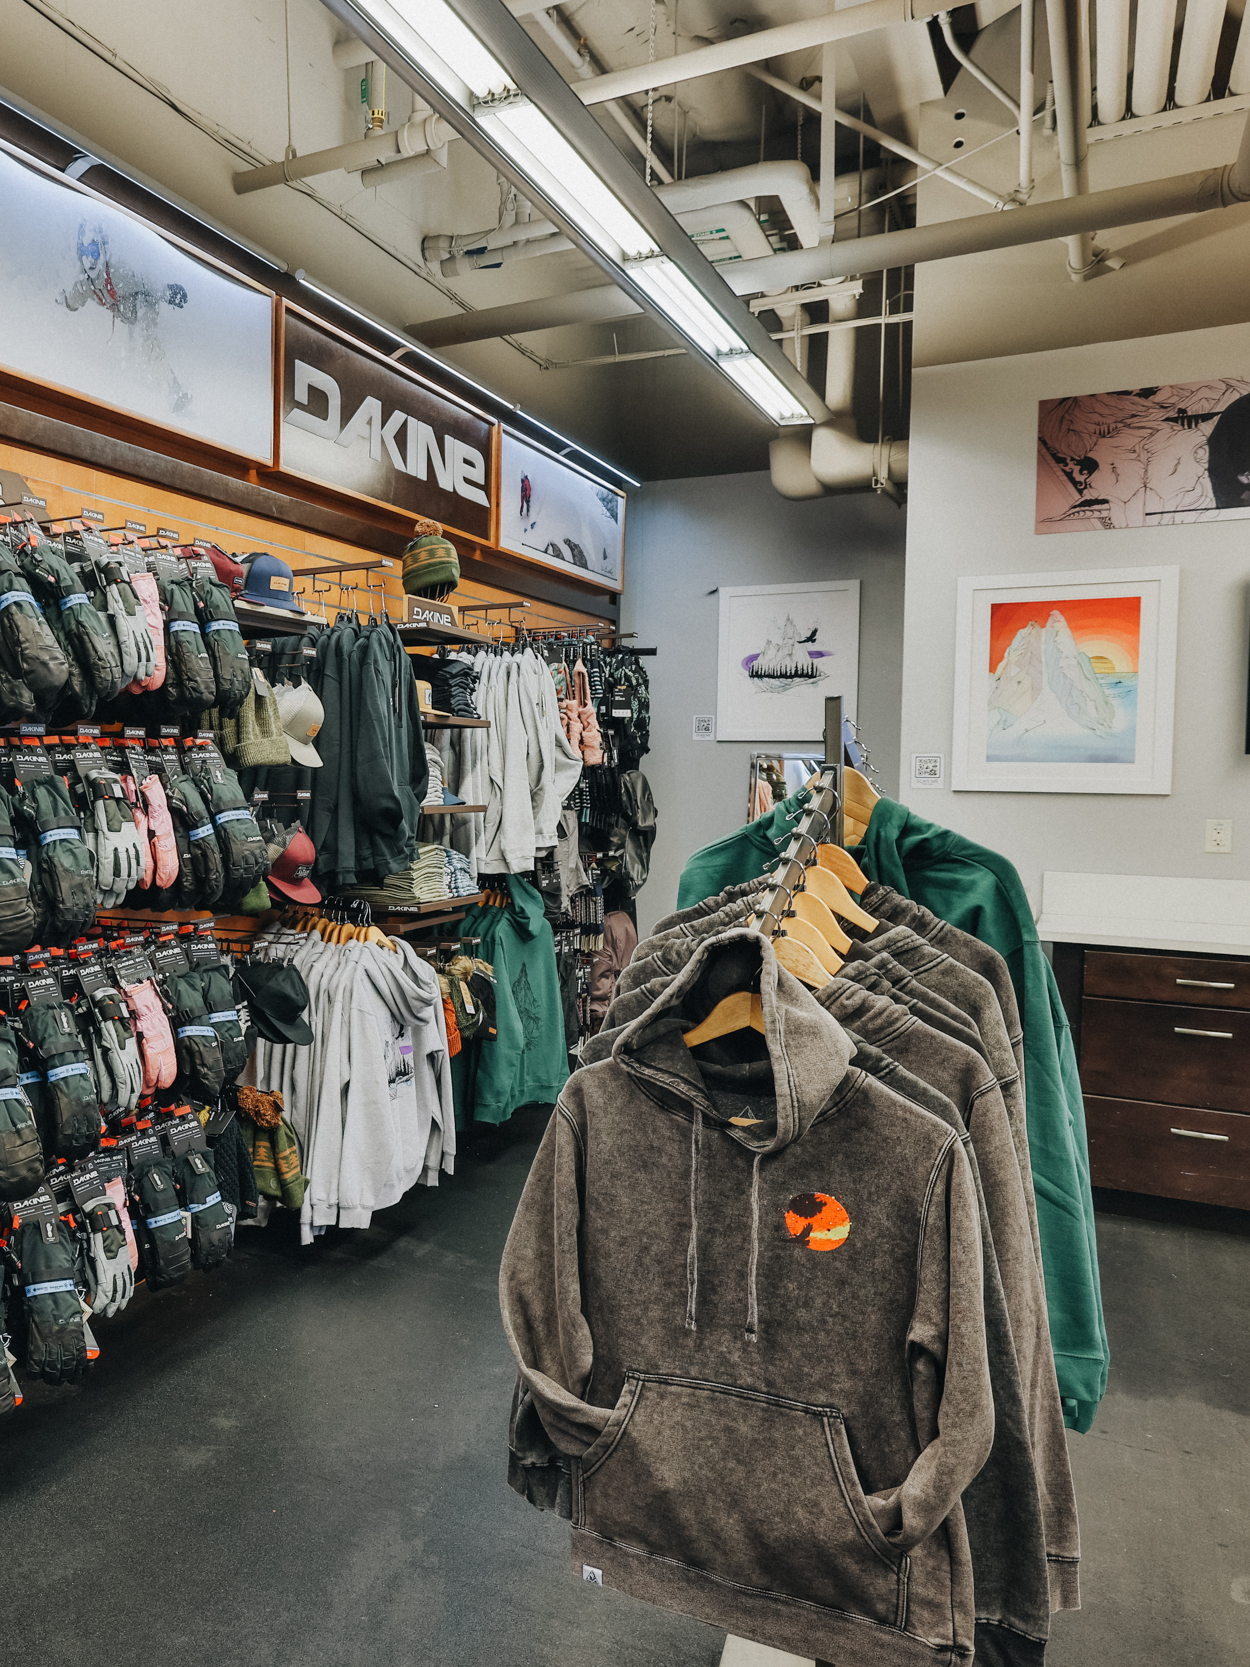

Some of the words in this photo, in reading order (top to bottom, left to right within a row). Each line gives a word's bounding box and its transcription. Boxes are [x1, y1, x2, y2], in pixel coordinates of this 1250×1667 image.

[284, 359, 490, 507] DAKINE
[23, 495, 47, 507] DAKINE
[83, 510, 104, 520] DAKINE
[126, 522, 146, 532] DAKINE
[159, 529, 179, 539] DAKINE
[156, 553, 177, 562] DAKINE
[413, 607, 452, 626] DAKINE
[16, 755, 49, 763] DAKINE
[78, 943, 99, 951] DAKINE
[28, 953, 51, 961] DAKINE
[155, 948, 182, 958] DAKINE
[79, 965, 101, 975] DAKINE
[28, 977, 54, 988] DAKINE
[170, 1121, 198, 1134] DAKINE
[131, 1136, 158, 1148] DAKINE
[73, 1171, 99, 1185] DAKINE
[13, 1195, 51, 1209] DAKINE
